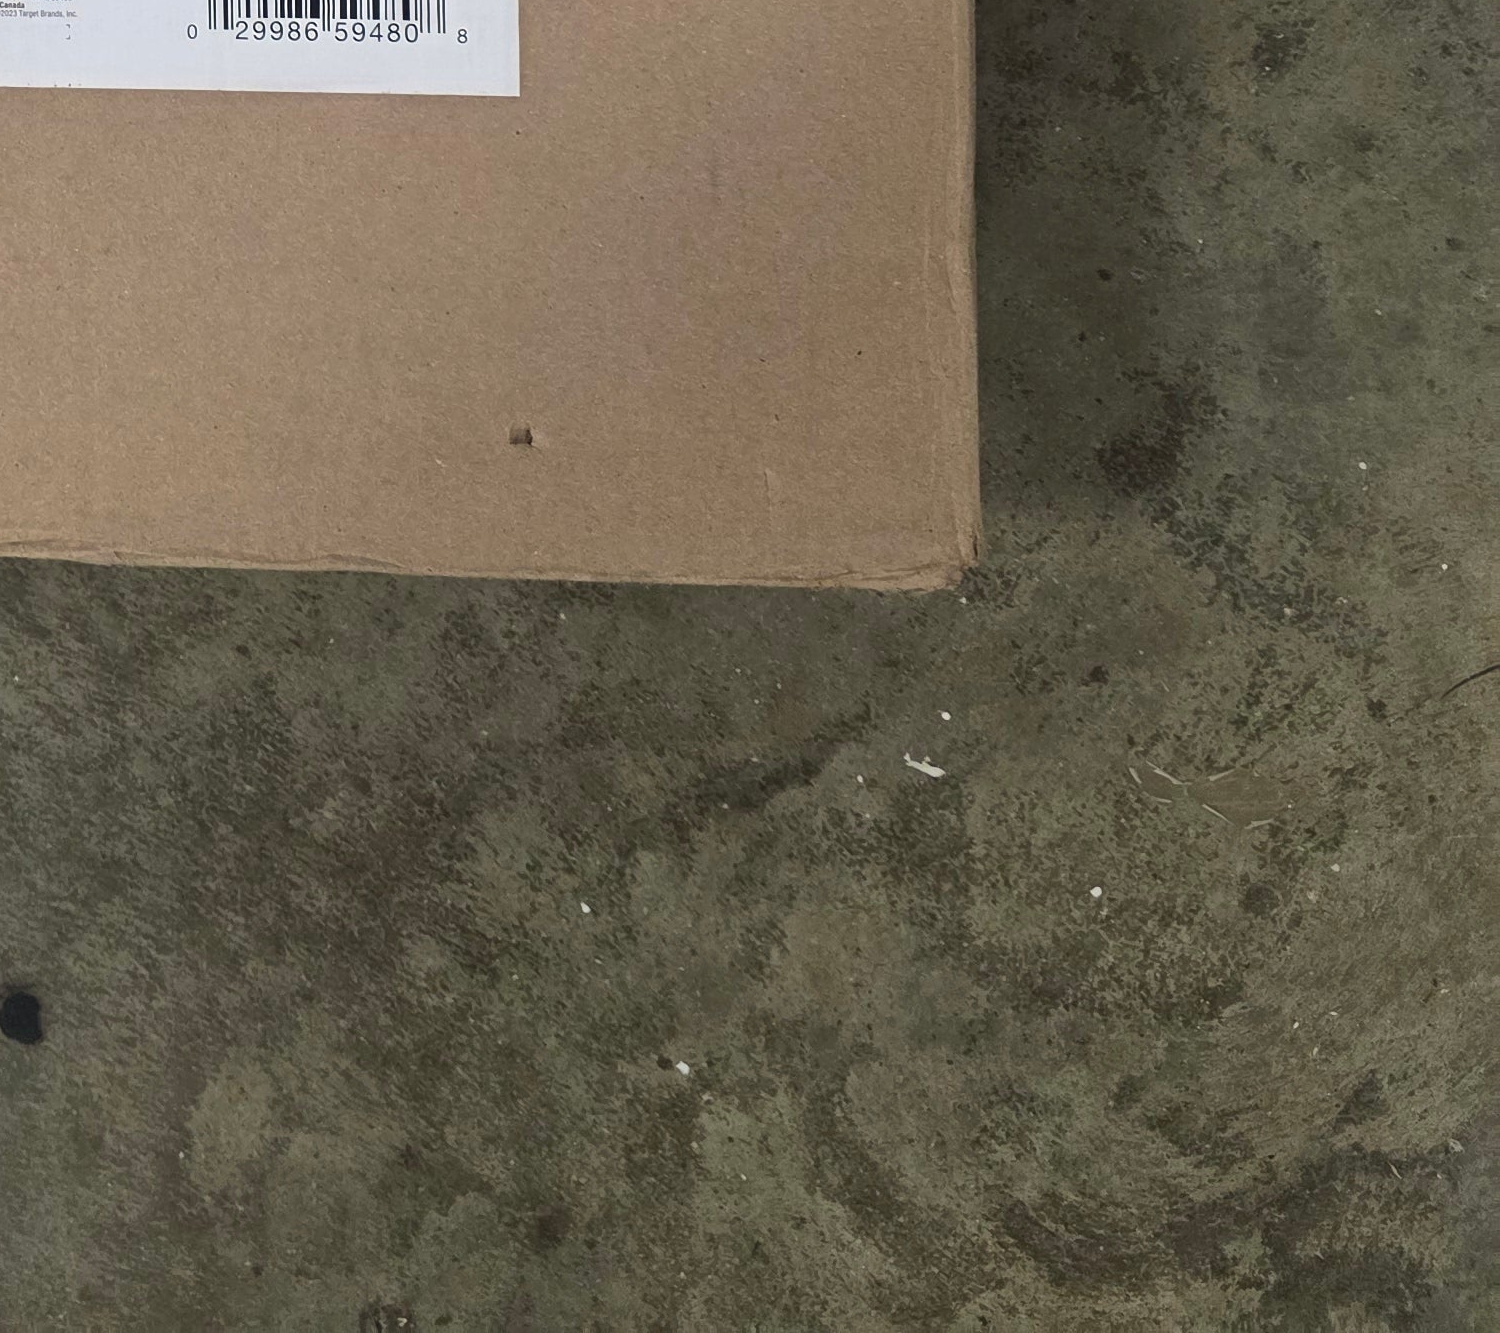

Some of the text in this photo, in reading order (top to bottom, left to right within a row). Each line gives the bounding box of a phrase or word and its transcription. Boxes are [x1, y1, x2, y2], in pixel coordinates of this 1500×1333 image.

[0, 2, 25, 10] Canada
[19, 10, 39, 18] Target
[41, 10, 64, 18] Brands,
[187, 22, 467, 45] 0 29986 59480 8
